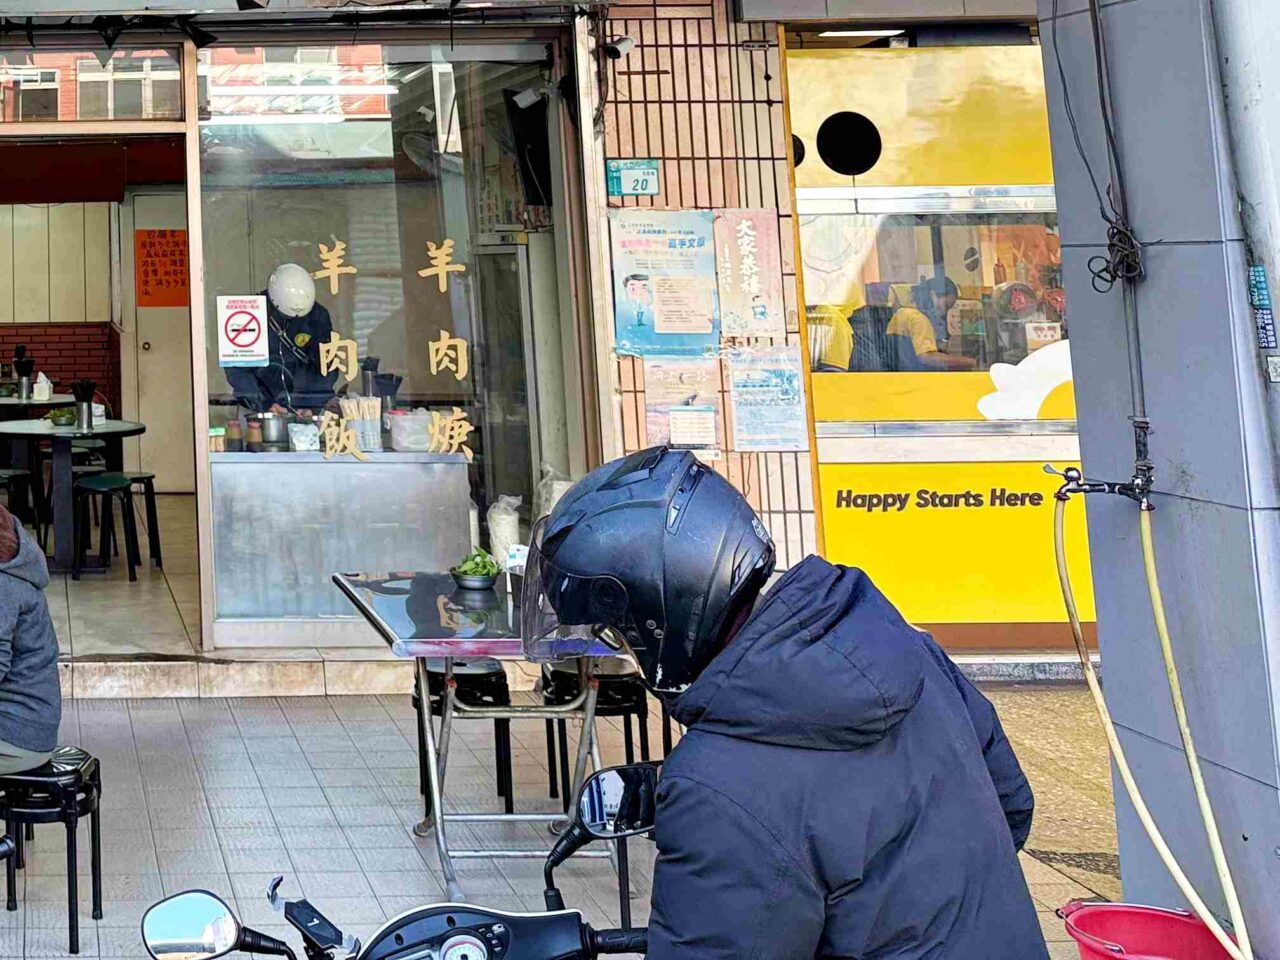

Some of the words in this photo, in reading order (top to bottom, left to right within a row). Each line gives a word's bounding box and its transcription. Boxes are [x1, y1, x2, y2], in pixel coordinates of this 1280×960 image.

[631, 178, 649, 192] 20
[311, 239, 369, 462] 羊肉飯
[836, 489, 910, 512] Happy
[915, 489, 984, 508] Starts
[989, 488, 1044, 507] Here
